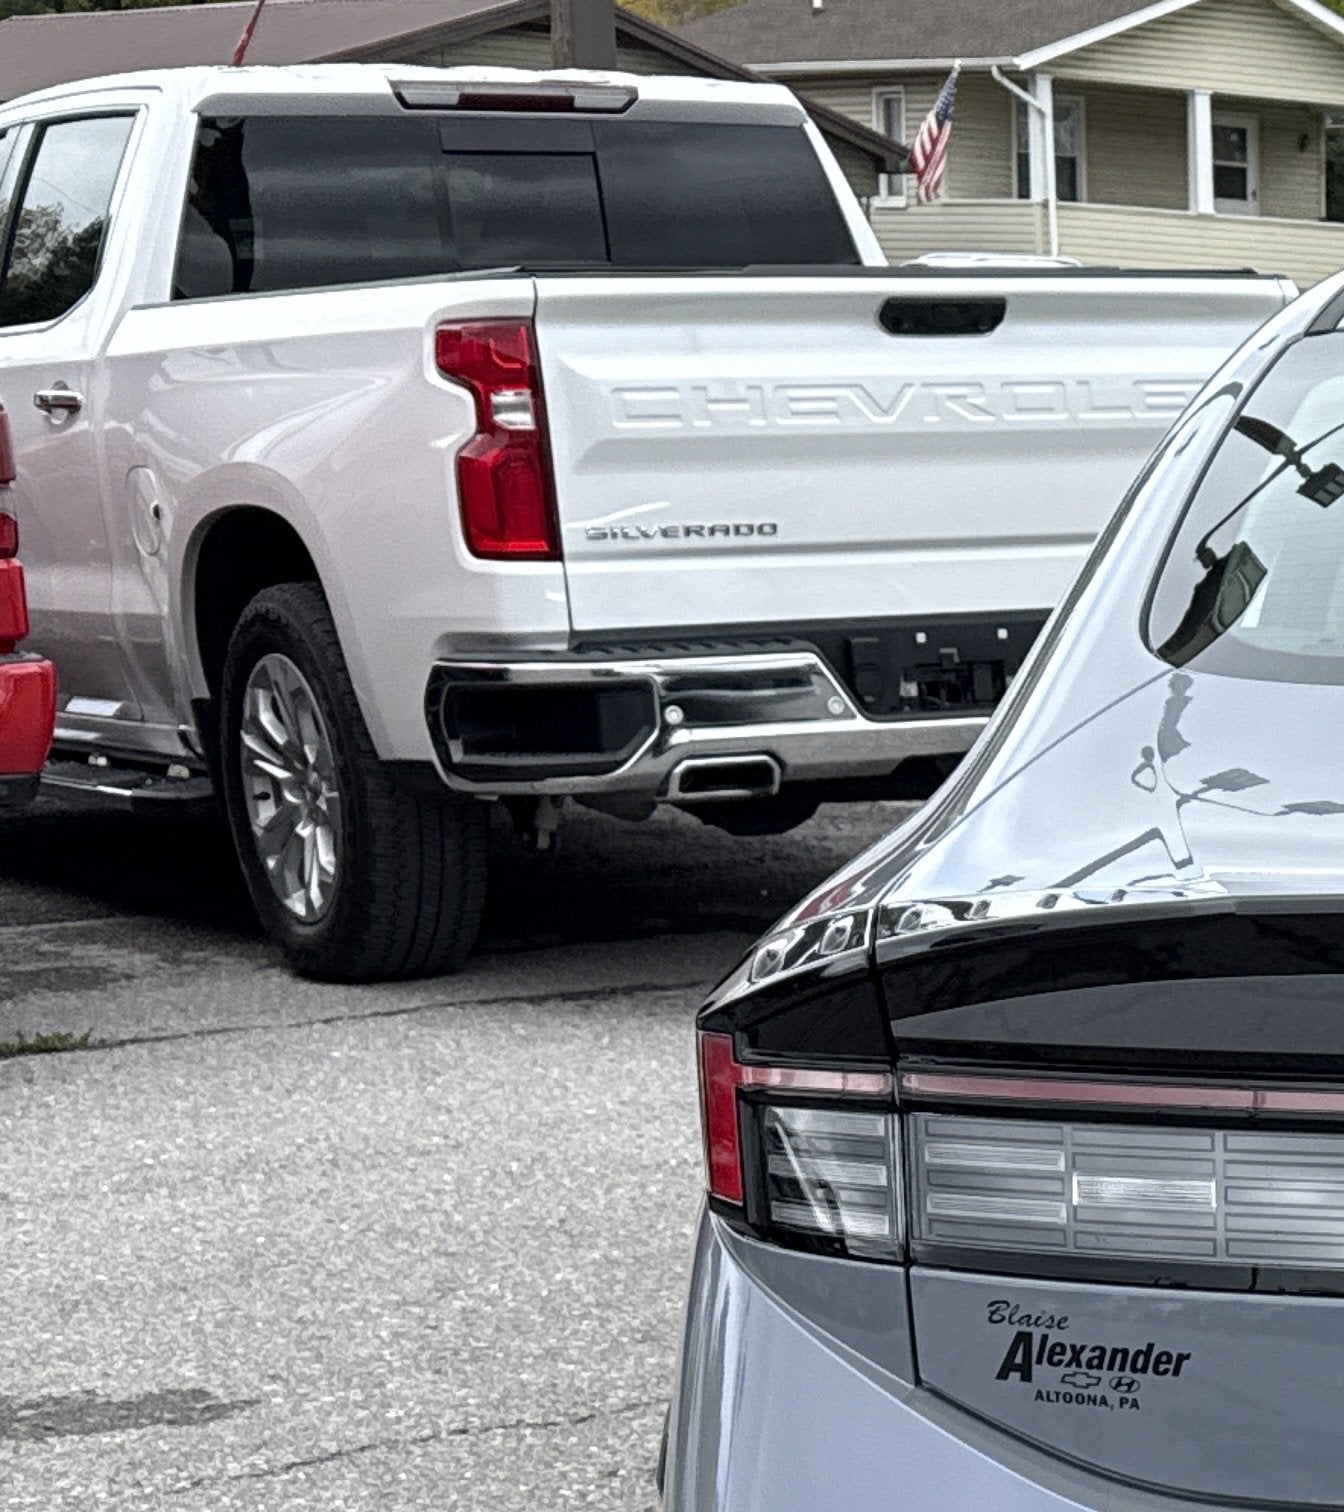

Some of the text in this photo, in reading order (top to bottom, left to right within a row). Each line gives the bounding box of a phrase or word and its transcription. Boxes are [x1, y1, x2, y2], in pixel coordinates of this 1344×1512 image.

[609, 380, 1206, 428] CHEVROLE
[584, 522, 778, 540] SILVERADO
[986, 1299, 1070, 1331] Blaise
[995, 1330, 1191, 1383] Alexander
[1034, 1389, 1140, 1412] ALTOONA, PA
